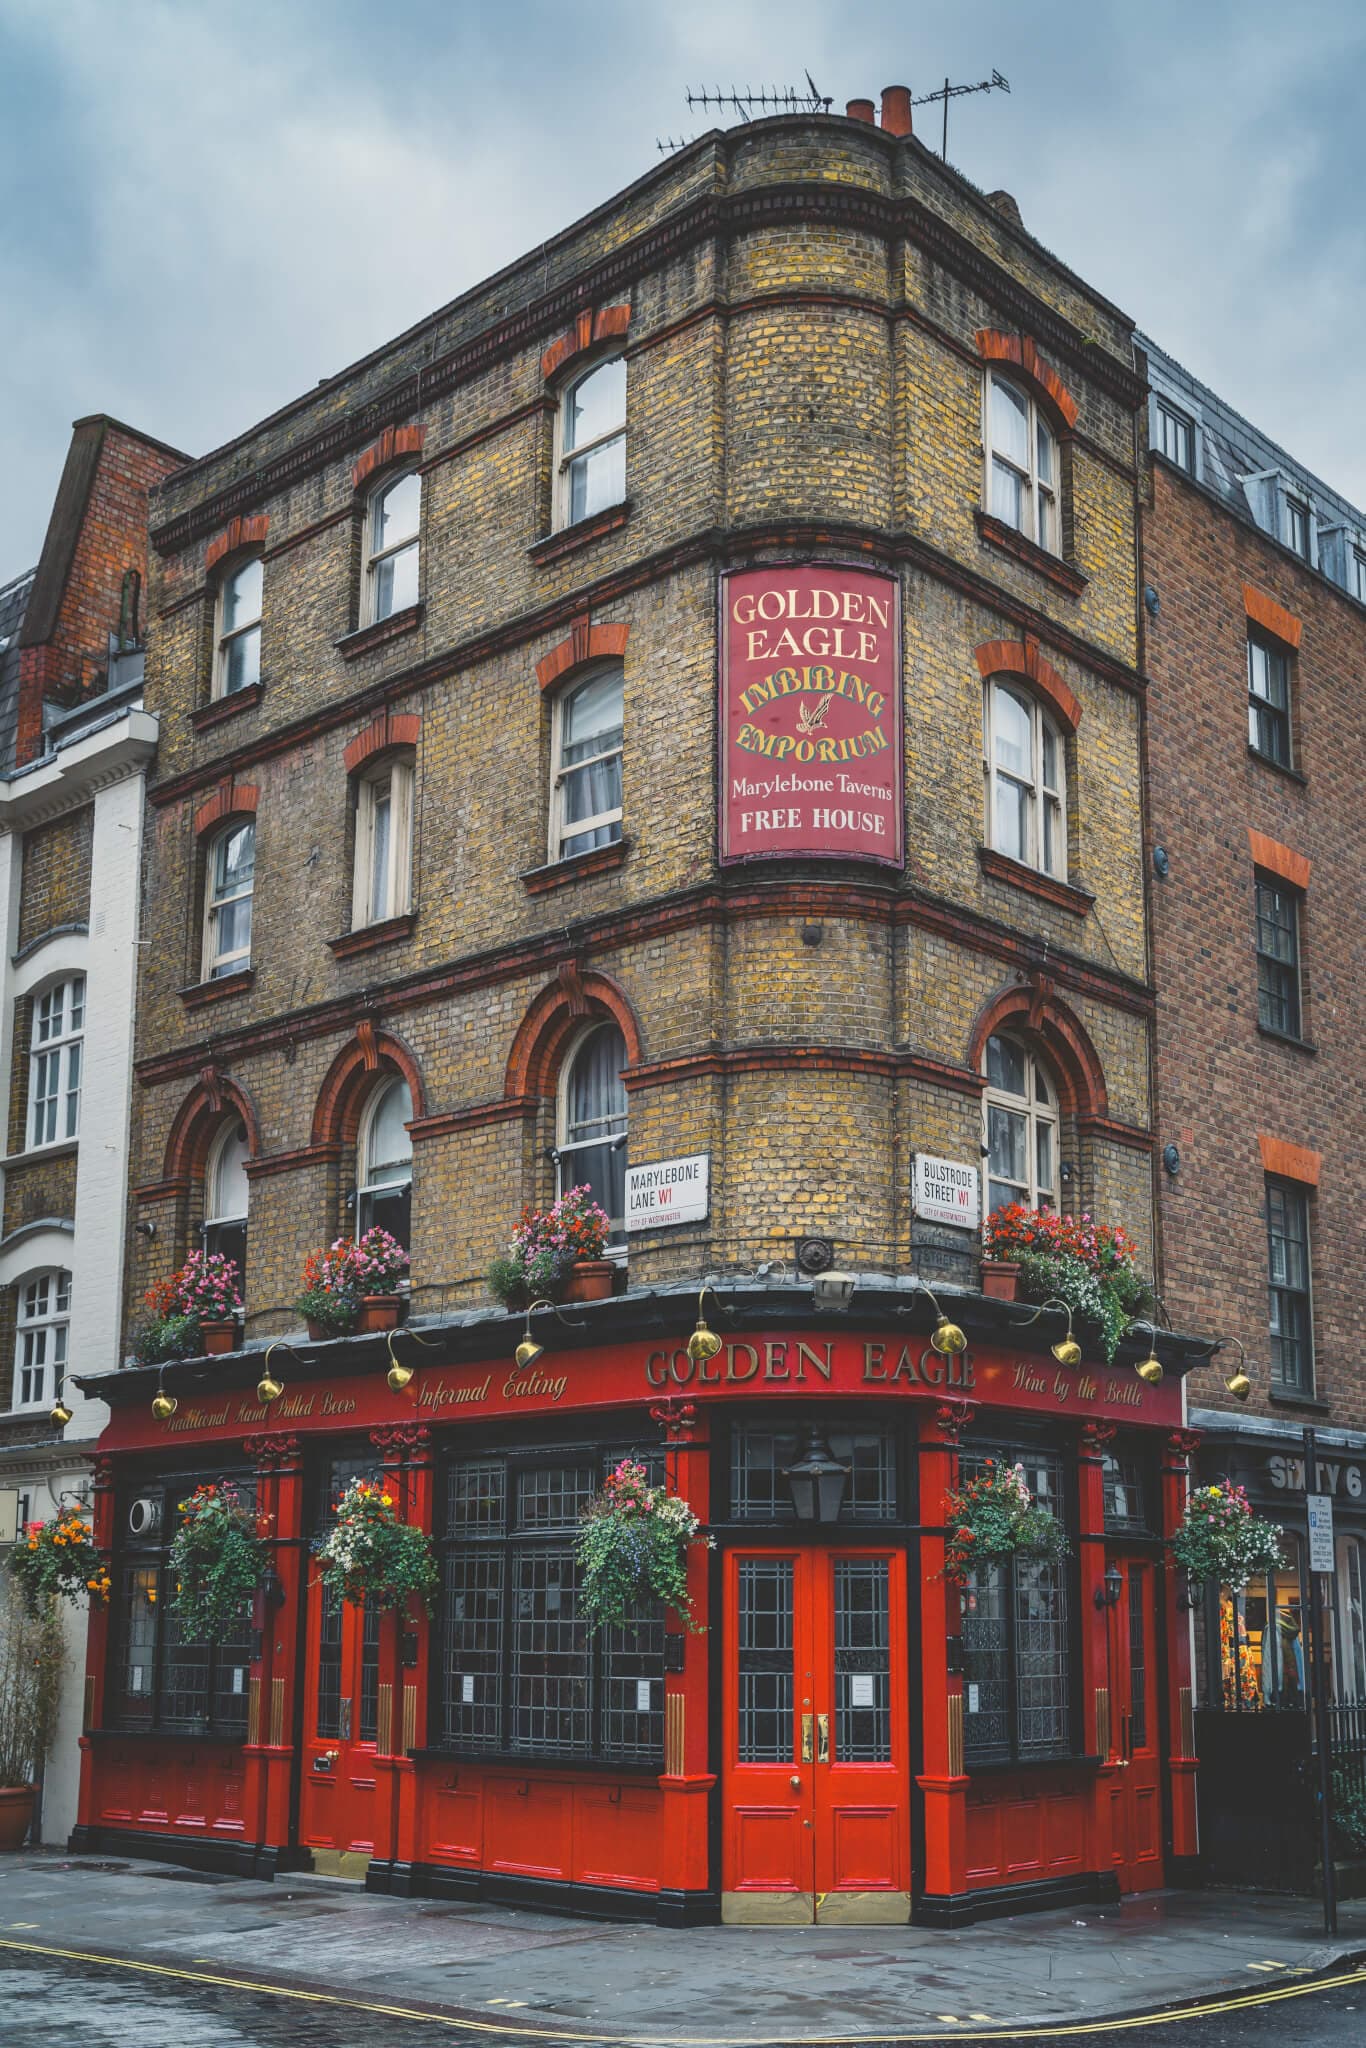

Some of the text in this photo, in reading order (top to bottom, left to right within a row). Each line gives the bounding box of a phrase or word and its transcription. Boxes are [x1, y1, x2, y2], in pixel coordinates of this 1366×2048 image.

[732, 589, 890, 629] GOLDEN
[746, 627, 880, 663] EAGLE
[738, 664, 885, 717] IMBIBING
[735, 723, 889, 764] EMPORIUM
[732, 774, 892, 801] Marylebone Taverns
[741, 808, 885, 835] FREE HOUSE
[631, 1163, 699, 1191] MARYLEBONE
[924, 1162, 973, 1188] BULSTRODE
[631, 1187, 672, 1210] LANE W1
[924, 1182, 969, 1207] STREET W1
[645, 1342, 976, 1388] GOLDEN EAGLE
[412, 1370, 568, 1412] Informal Eating
[1012, 1361, 1143, 1408] Wine by the Bottle
[234, 1400, 269, 1424] Hand
[274, 1394, 315, 1418] Pulled
[320, 1391, 356, 1416] Beers
[1346, 1465, 1362, 1497] 6
